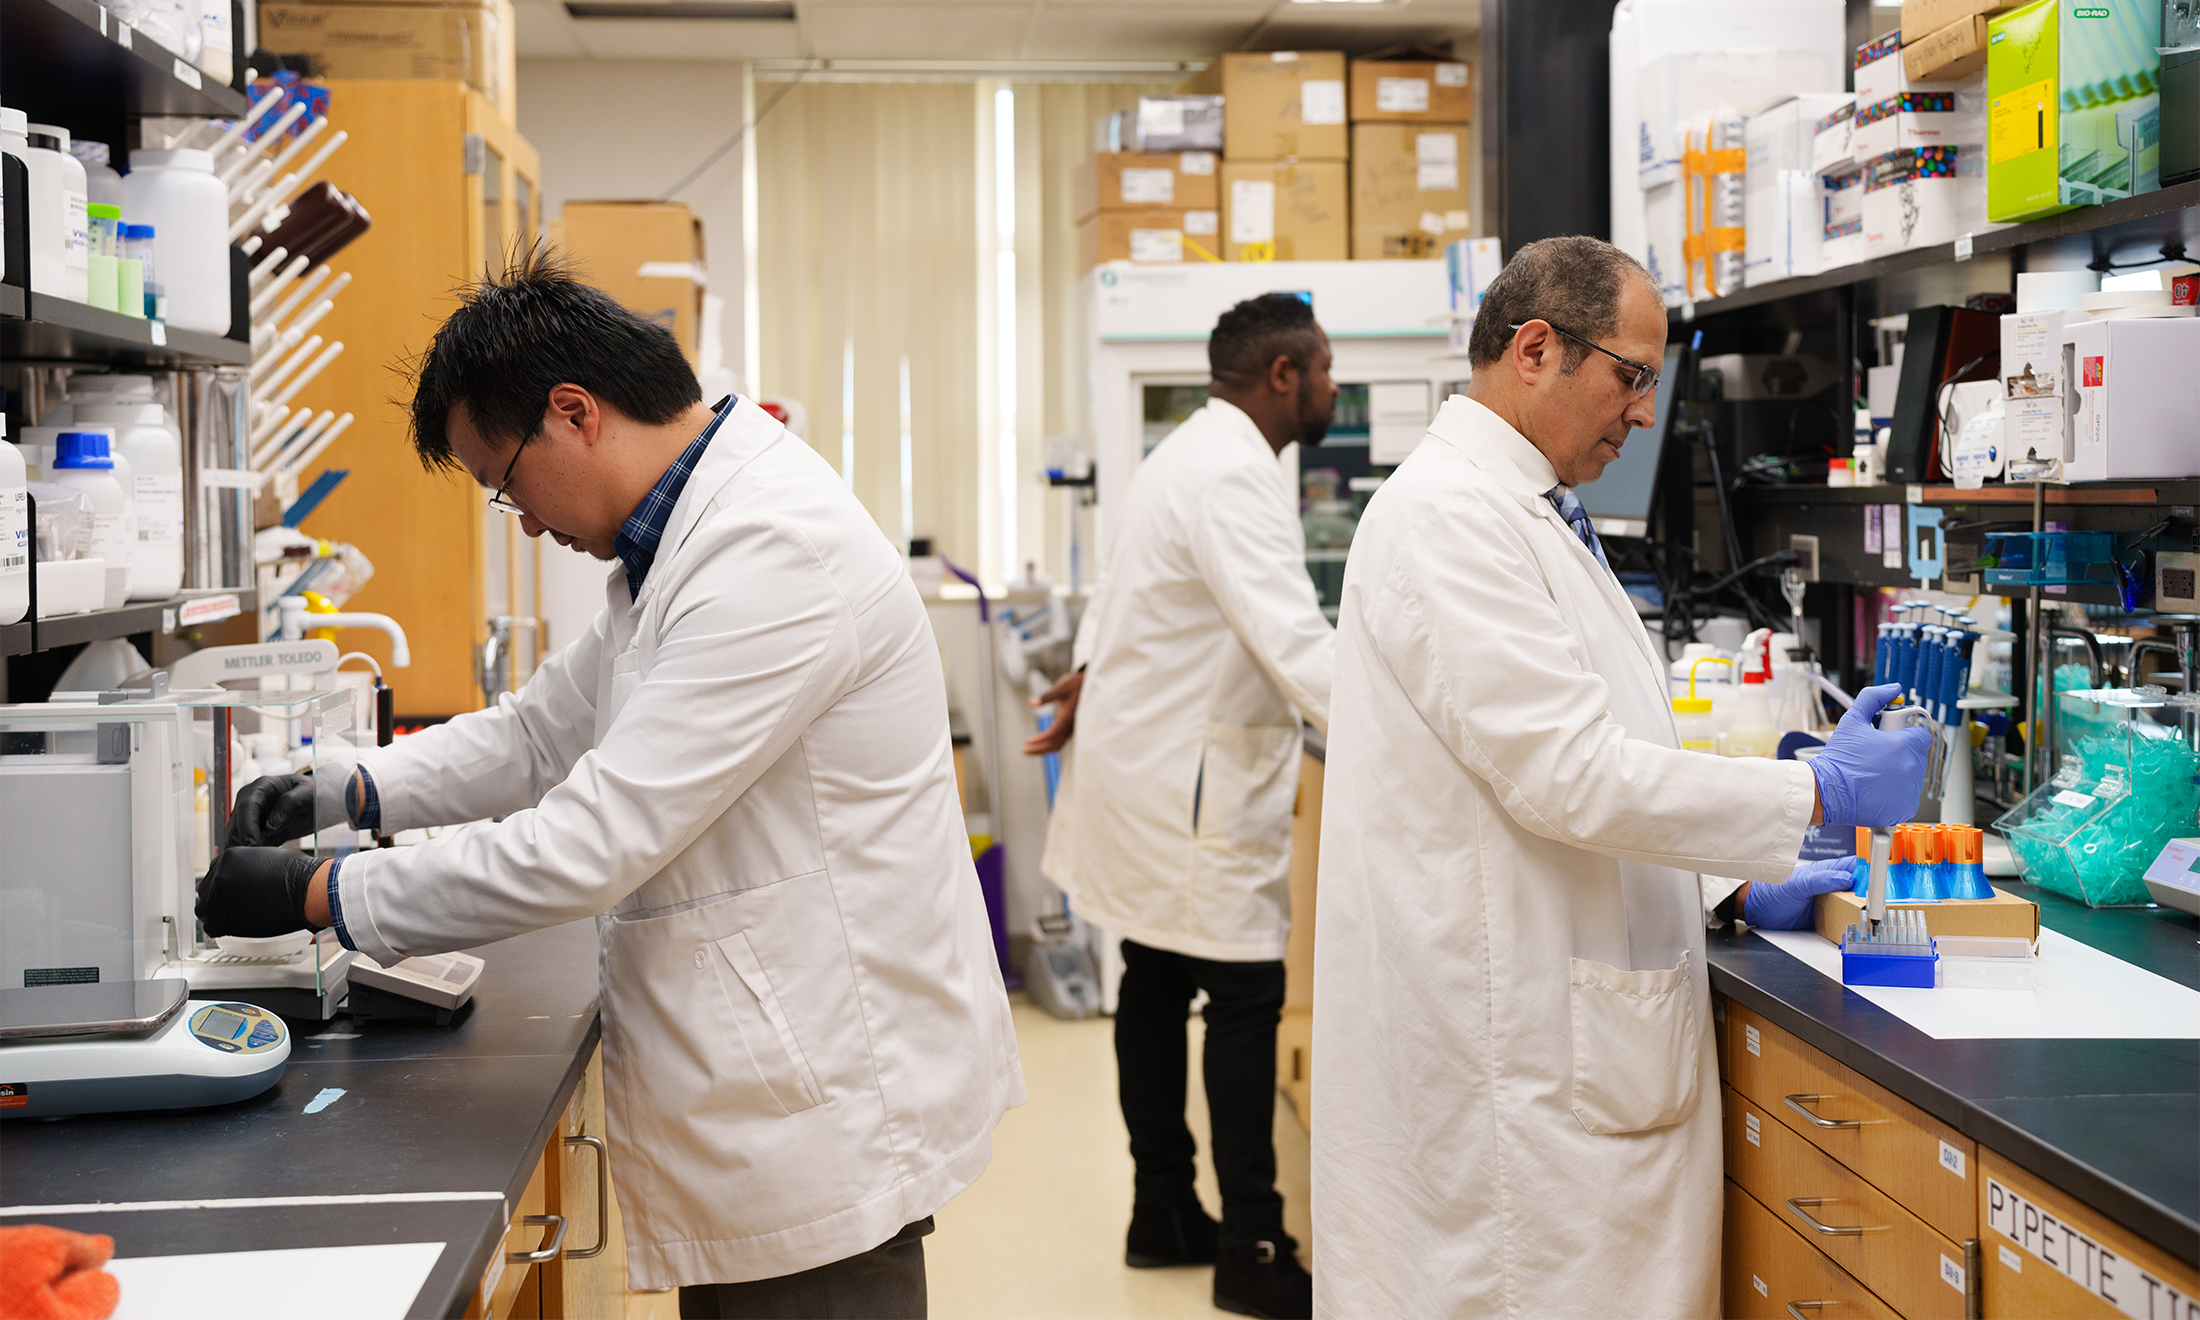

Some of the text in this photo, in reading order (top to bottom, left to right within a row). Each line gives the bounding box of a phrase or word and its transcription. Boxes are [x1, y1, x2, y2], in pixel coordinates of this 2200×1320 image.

[225, 650, 322, 669] METTLER TOLEDO
[1944, 1148, 1958, 1169] D2-2
[1990, 1181, 2118, 1304] PIPETTE
